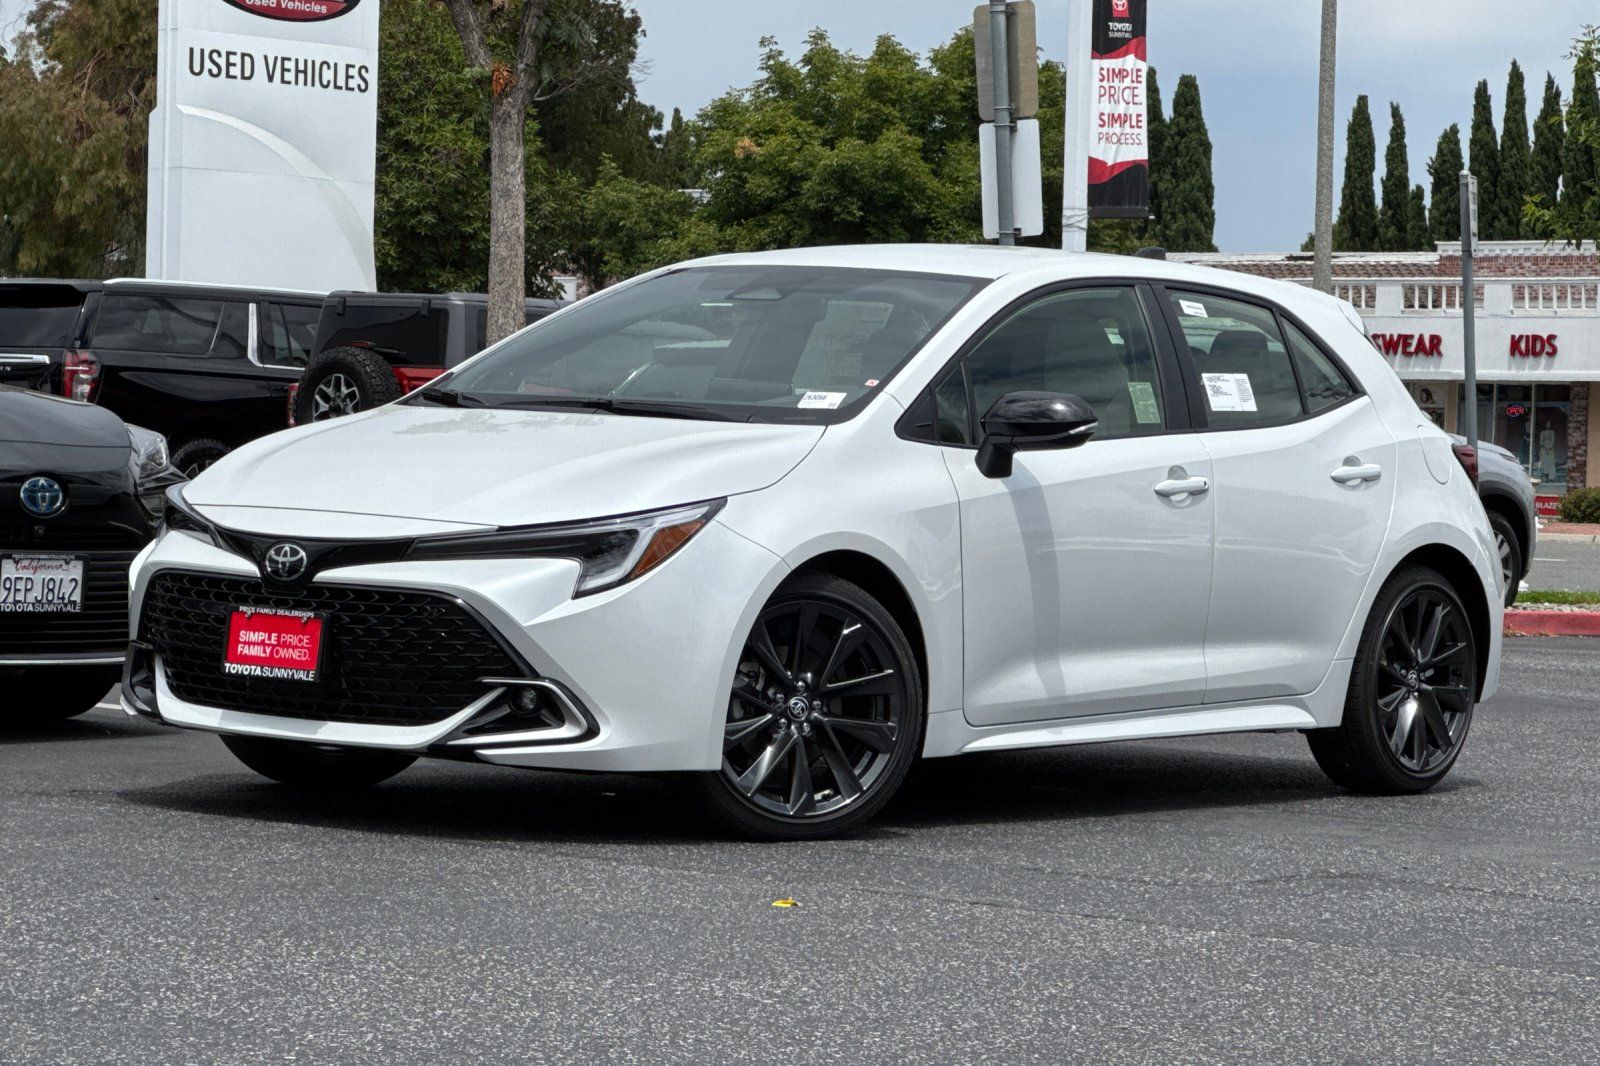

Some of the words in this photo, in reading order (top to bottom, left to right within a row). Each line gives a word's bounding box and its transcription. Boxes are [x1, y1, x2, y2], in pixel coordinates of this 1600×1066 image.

[280, 0, 328, 14] Vehicles
[1107, 22, 1133, 32] TOYOTA
[188, 47, 255, 81] USED
[263, 54, 369, 93] VEHICLES
[1098, 67, 1143, 84] SIMPLE
[1098, 86, 1143, 105] PRICE.
[1098, 112, 1143, 129] SIMPLE
[1097, 132, 1143, 146] PROCESS.
[1509, 334, 1558, 357] KIDS
[1506, 406, 1525, 416] OPEN
[16, 559, 68, 575] California
[2, 576, 79, 604] 9EPJ842
[0, 603, 34, 612] TOYOTA
[34, 603, 82, 613] SUNNYVALE
[256, 607, 277, 615] FAMILY
[277, 609, 315, 618] DEALERSHIPS
[239, 630, 278, 645] SIMPLE
[280, 633, 312, 648] PRICE.
[237, 643, 272, 658] FAMILY
[273, 646, 311, 661] OWNED.
[224, 663, 262, 677] TOYOTA
[262, 666, 316, 682] SUNNYVALE
